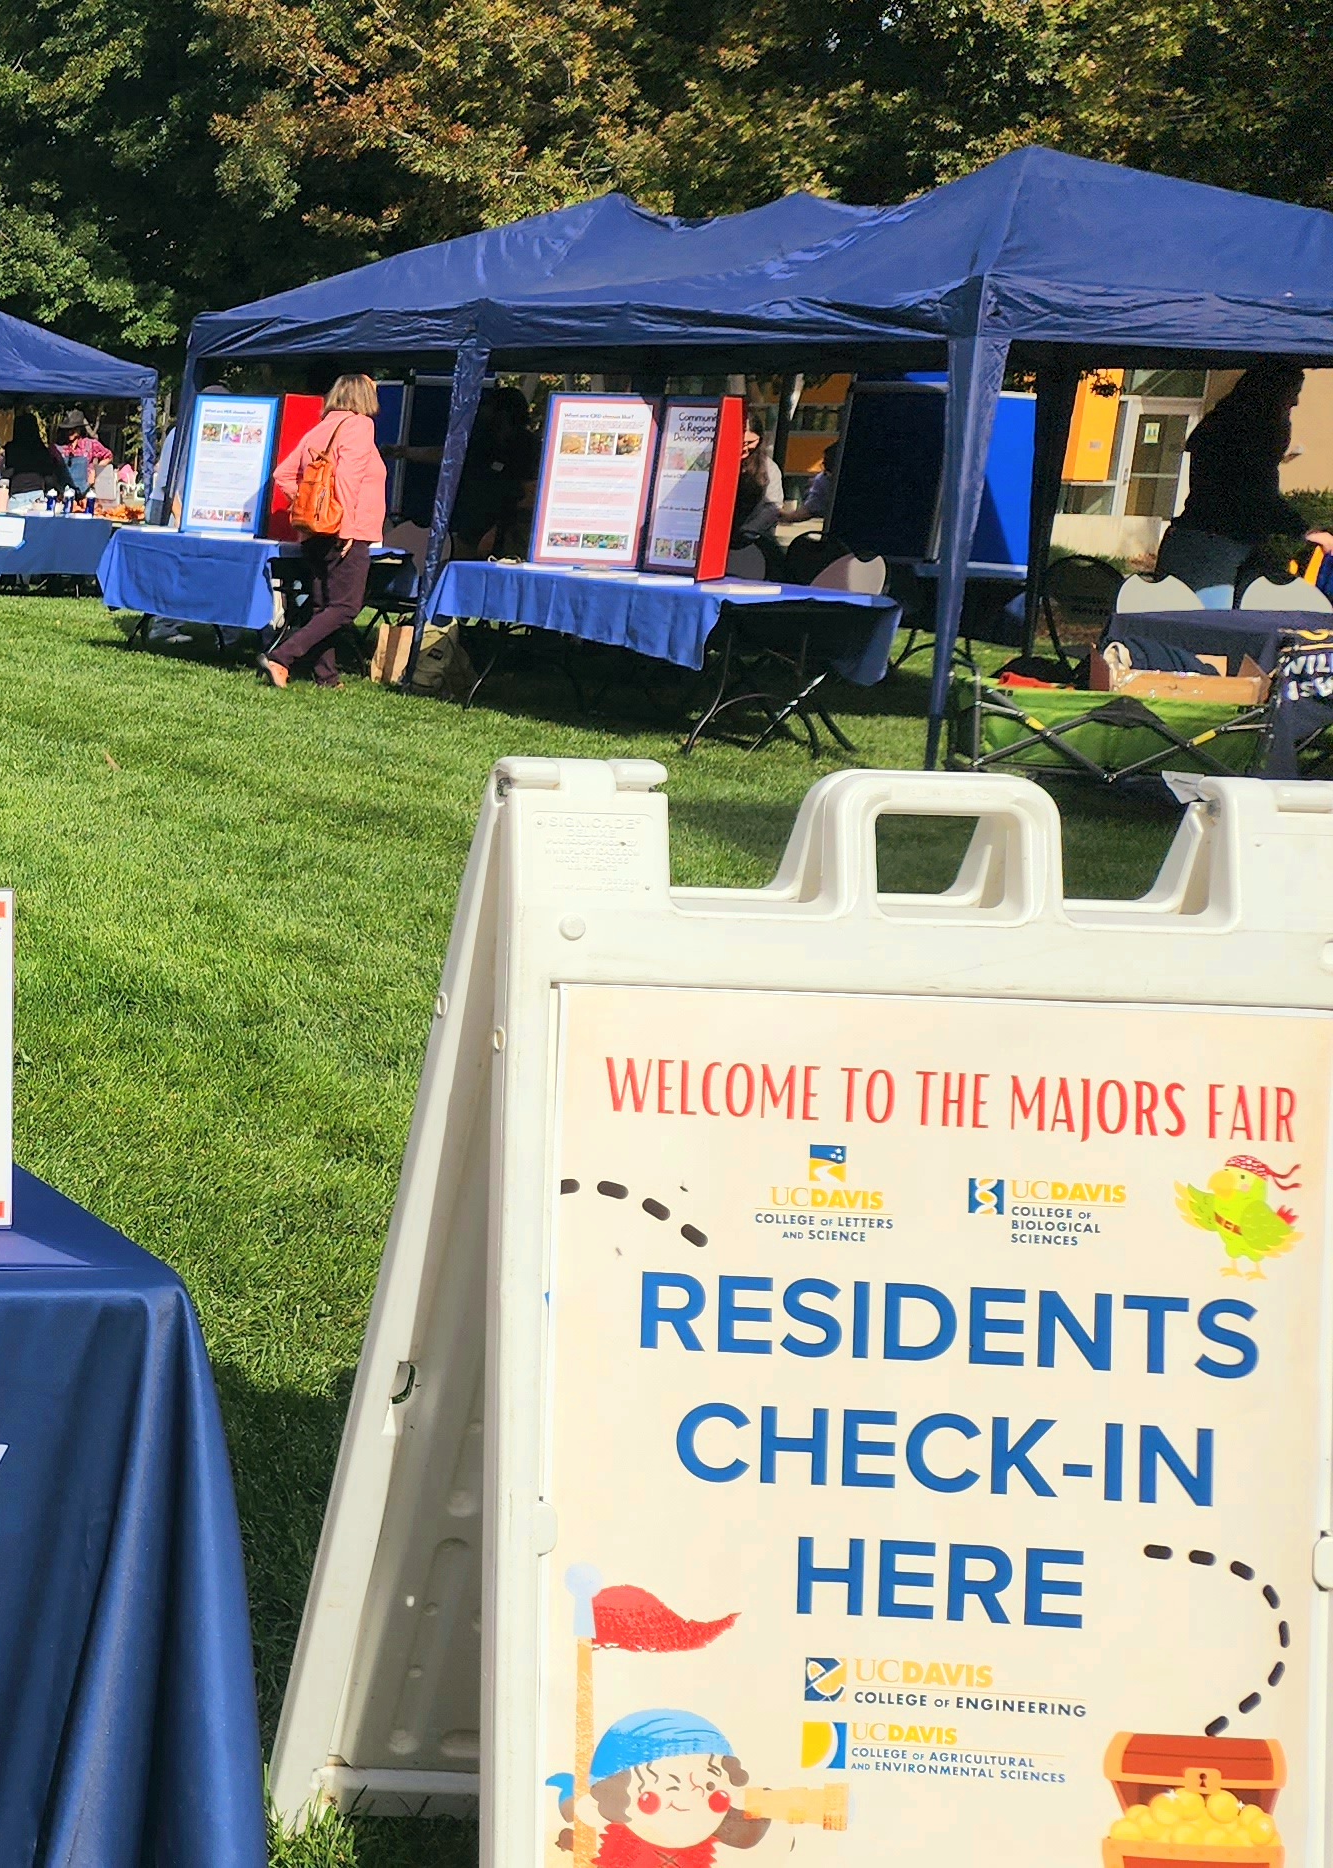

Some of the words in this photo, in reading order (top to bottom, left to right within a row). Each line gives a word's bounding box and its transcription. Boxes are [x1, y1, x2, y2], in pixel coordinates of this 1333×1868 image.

[679, 411, 718, 422] Communi
[679, 422, 686, 432] &
[687, 422, 716, 434] Region
[673, 432, 714, 444] Developm
[605, 1056, 821, 1122] WELCOME
[841, 1067, 895, 1124] TO
[915, 1070, 991, 1130] THE
[1010, 1074, 1187, 1142] MAJORS
[1208, 1082, 1298, 1143] FAIR
[770, 1186, 884, 1210] UCDAVIS
[1010, 1180, 1127, 1204] UCDAVIS
[755, 1213, 815, 1226] COLLEGE
[820, 1218, 833, 1226] OF
[837, 1216, 894, 1230] LETTERS
[1011, 1206, 1073, 1219] COLLEGE
[1078, 1211, 1092, 1220] OF
[781, 1231, 804, 1240] AND
[808, 1230, 867, 1242] SCIENCE
[1011, 1220, 1101, 1234] BIOLOGICAL
[1011, 1233, 1079, 1246] SCIENCES
[638, 1271, 1260, 1379] RESIDENTS
[675, 1402, 1215, 1508] CHECK-IN
[795, 1536, 1085, 1630] HERE
[854, 1658, 994, 1688] UCDAVIS
[854, 1691, 927, 1707] COLLEGE
[933, 1698, 951, 1709] OF
[955, 1696, 1087, 1718] ENGINEERING
[851, 1722, 959, 1746] UCDAVIS
[851, 1748, 908, 1760] COLLEGE
[912, 1752, 925, 1761] OF
[929, 1751, 1035, 1768] AGRICULTURAL
[851, 1763, 871, 1771] AND
[875, 1760, 995, 1780] ENVIRONMENTAL
[1000, 1770, 1067, 1784] SCIENCES
